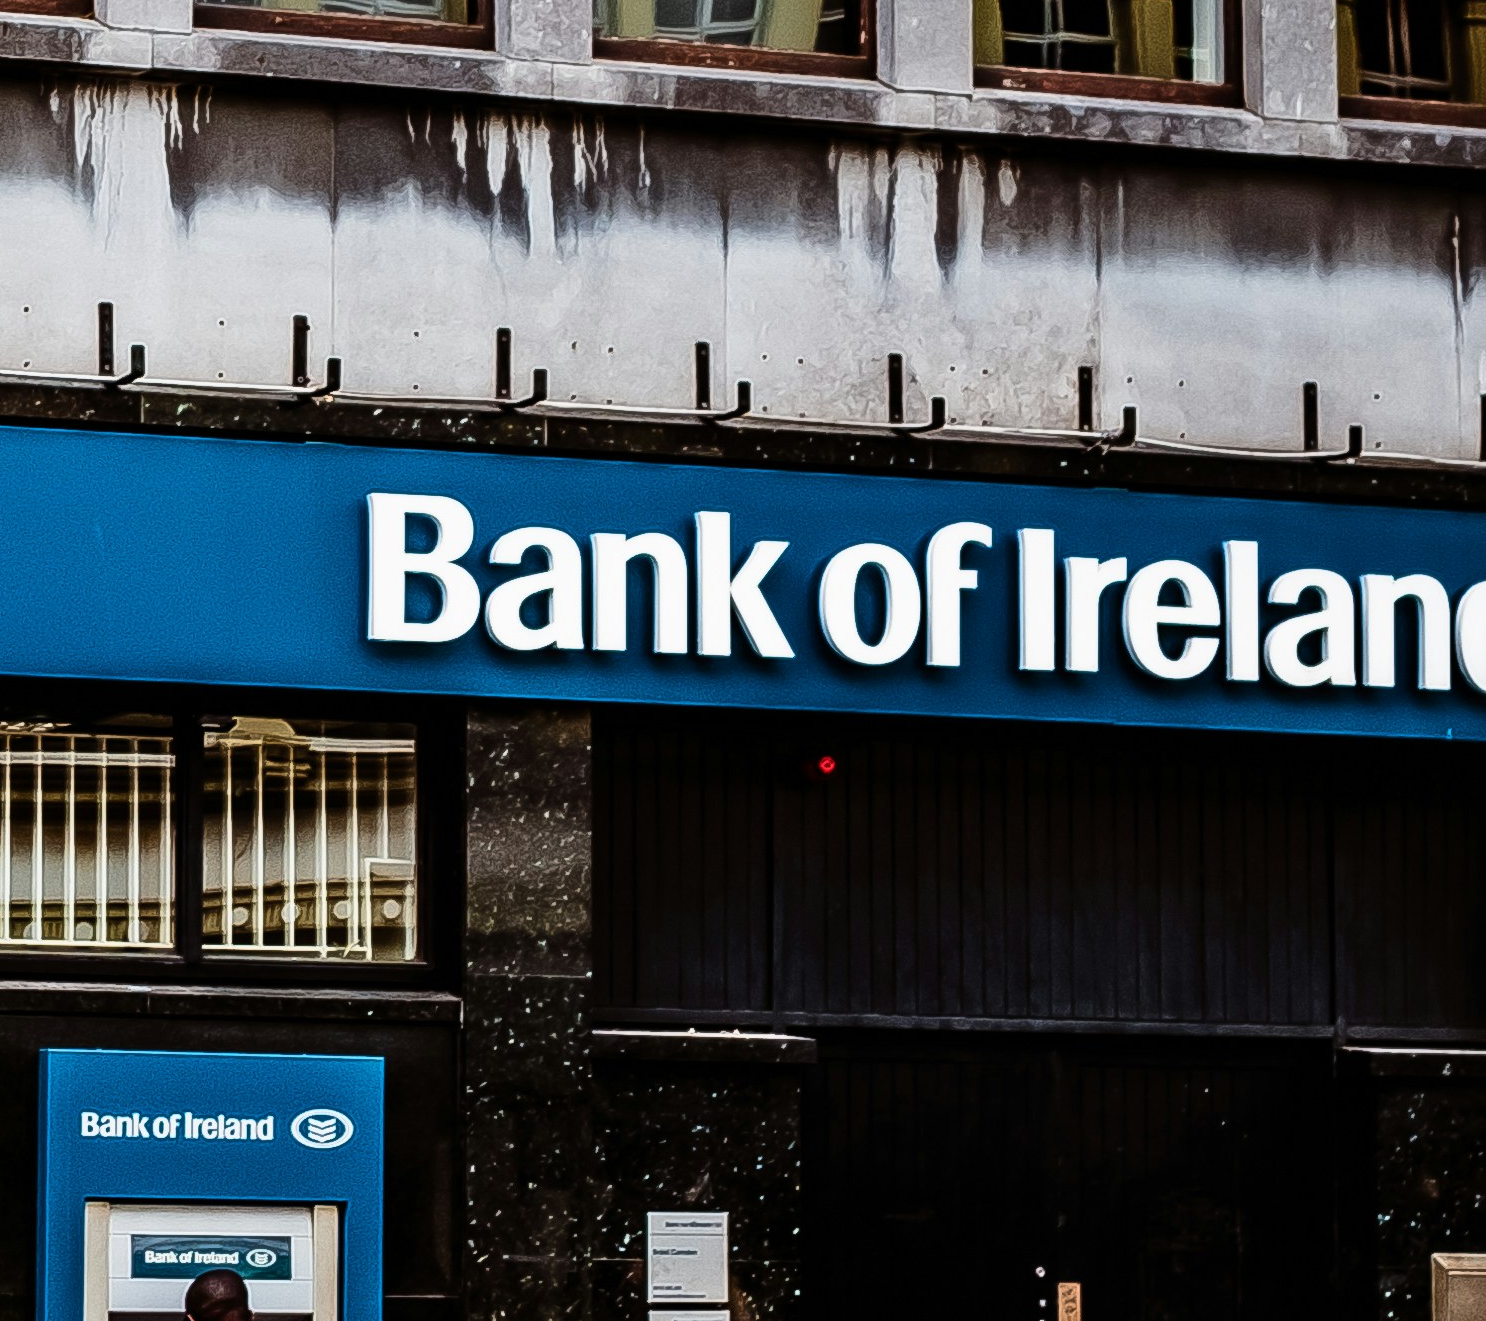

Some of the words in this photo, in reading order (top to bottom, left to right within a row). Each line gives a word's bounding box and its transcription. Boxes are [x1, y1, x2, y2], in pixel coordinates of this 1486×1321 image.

[365, 492, 796, 659] Bank
[819, 520, 993, 668] of
[81, 1111, 149, 1139] Bank
[153, 1113, 181, 1140] of
[184, 1111, 274, 1141] Ireland
[144, 1251, 179, 1264] Bank
[179, 1251, 193, 1264] of
[194, 1251, 239, 1265] Ireland
